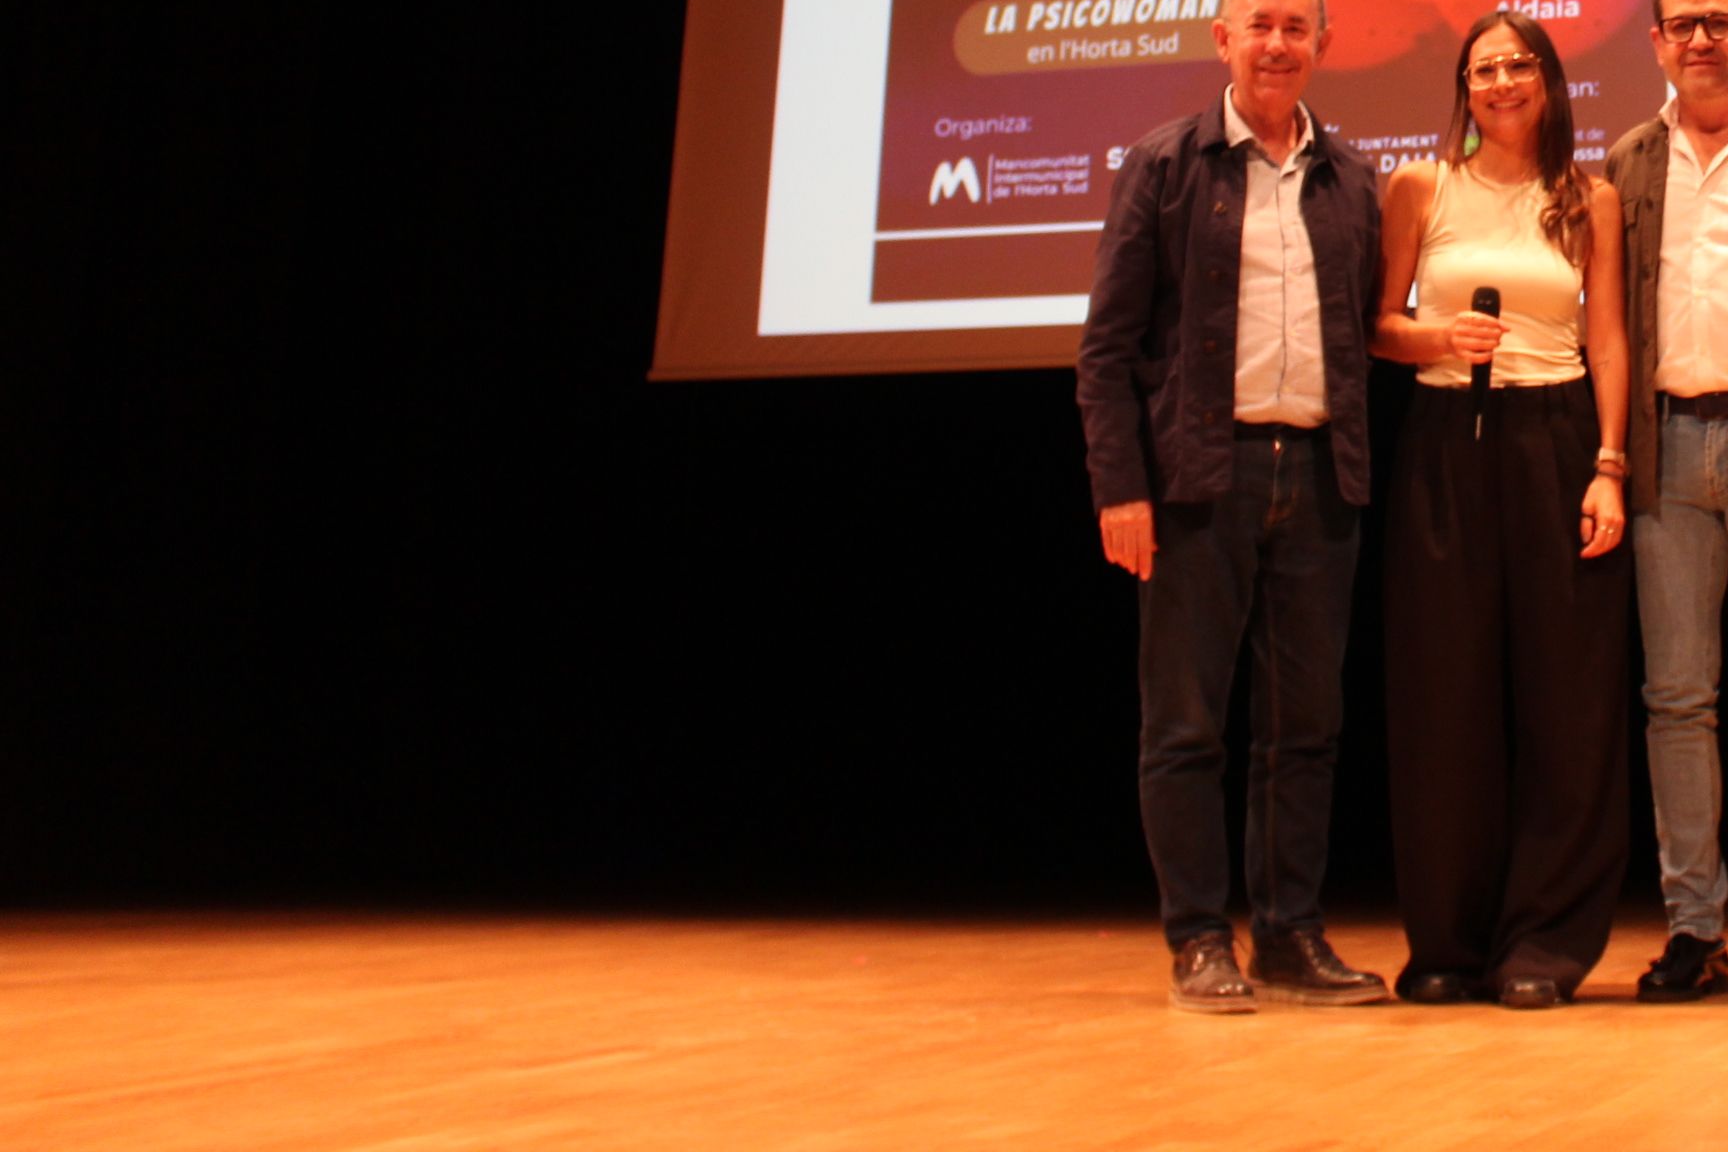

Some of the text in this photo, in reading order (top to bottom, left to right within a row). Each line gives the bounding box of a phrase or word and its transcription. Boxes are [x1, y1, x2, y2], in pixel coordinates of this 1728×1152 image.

[984, 3, 1017, 35] LA
[1027, 32, 1179, 64] en l'Horta Sud
[934, 114, 1032, 140] Organiza:
[1349, 133, 1439, 150] JUNTAMENT
[993, 185, 1010, 198] de
[1063, 181, 1089, 195] Sud
